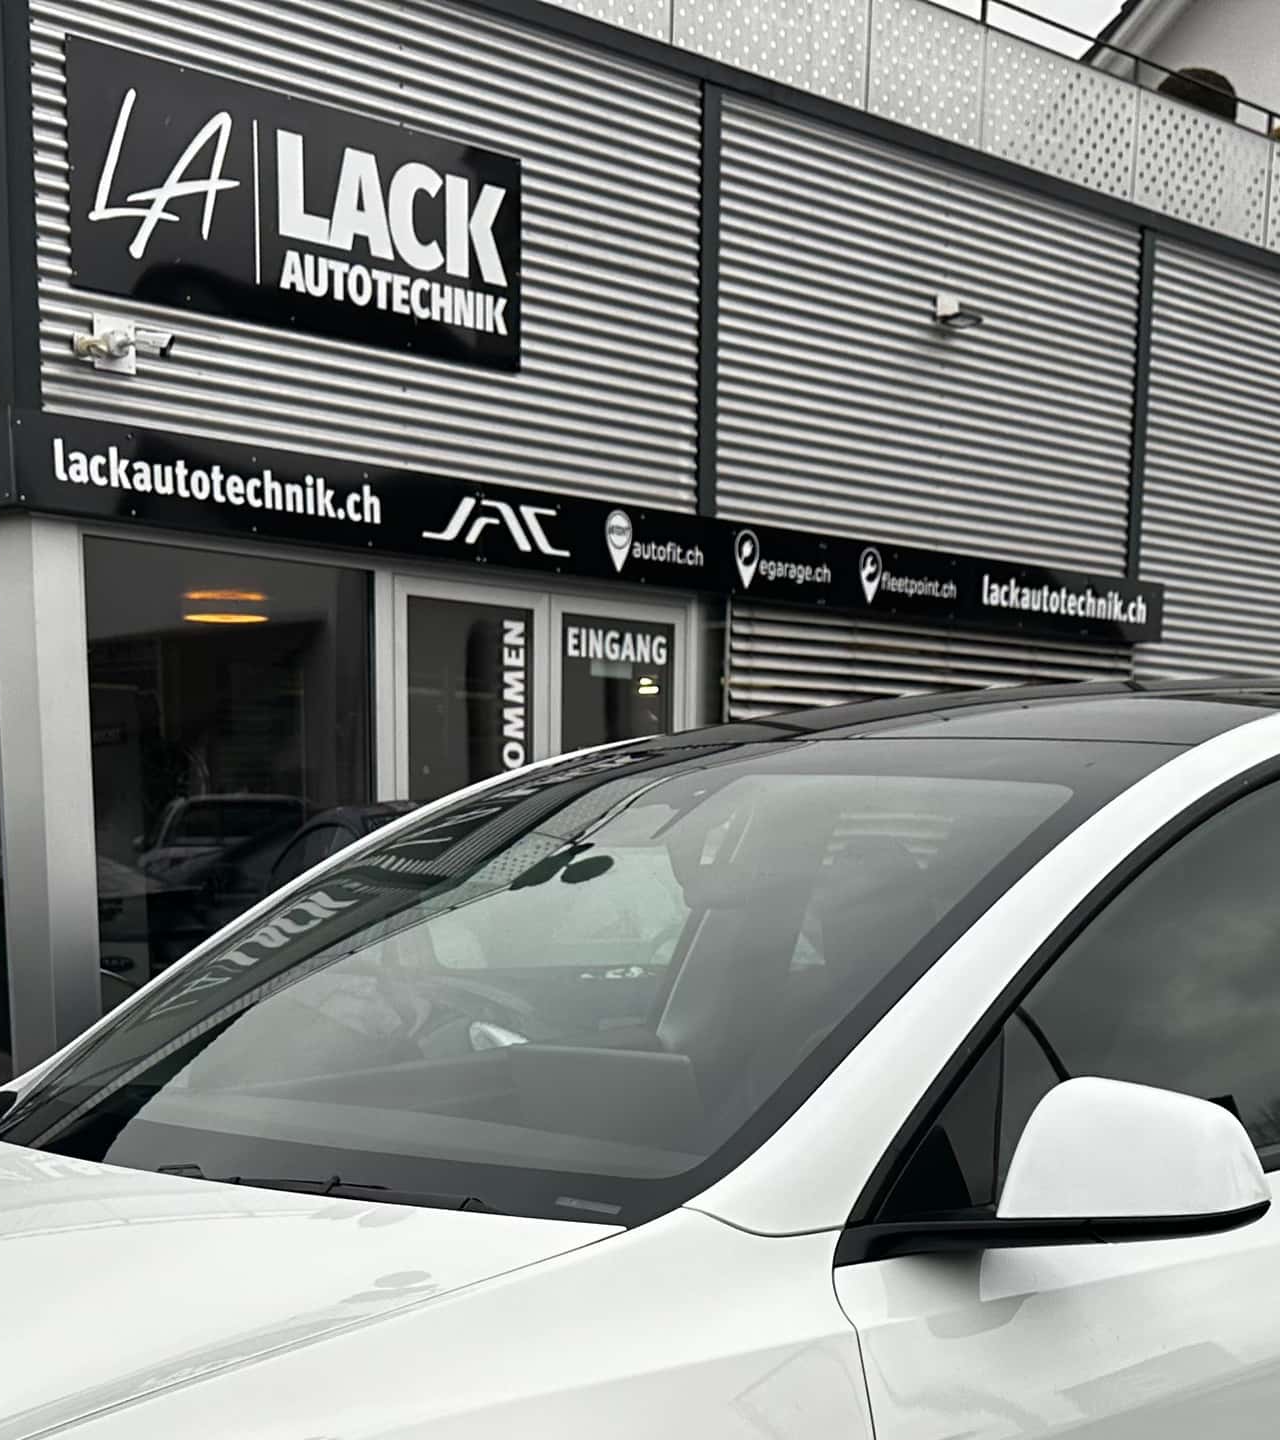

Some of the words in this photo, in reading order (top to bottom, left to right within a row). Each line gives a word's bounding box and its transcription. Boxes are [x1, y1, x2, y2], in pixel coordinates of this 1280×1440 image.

[276, 129, 508, 287] LACK
[279, 249, 508, 336] AUTOTECHNIK
[53, 438, 382, 524] lackautotechnik.ch
[631, 540, 705, 568] autofit.ch
[759, 558, 832, 585] egarage.ch
[880, 569, 958, 600] fleetpoint.ch
[981, 573, 1148, 625] lackautotechnik.ch
[567, 626, 668, 666] EINGANG
